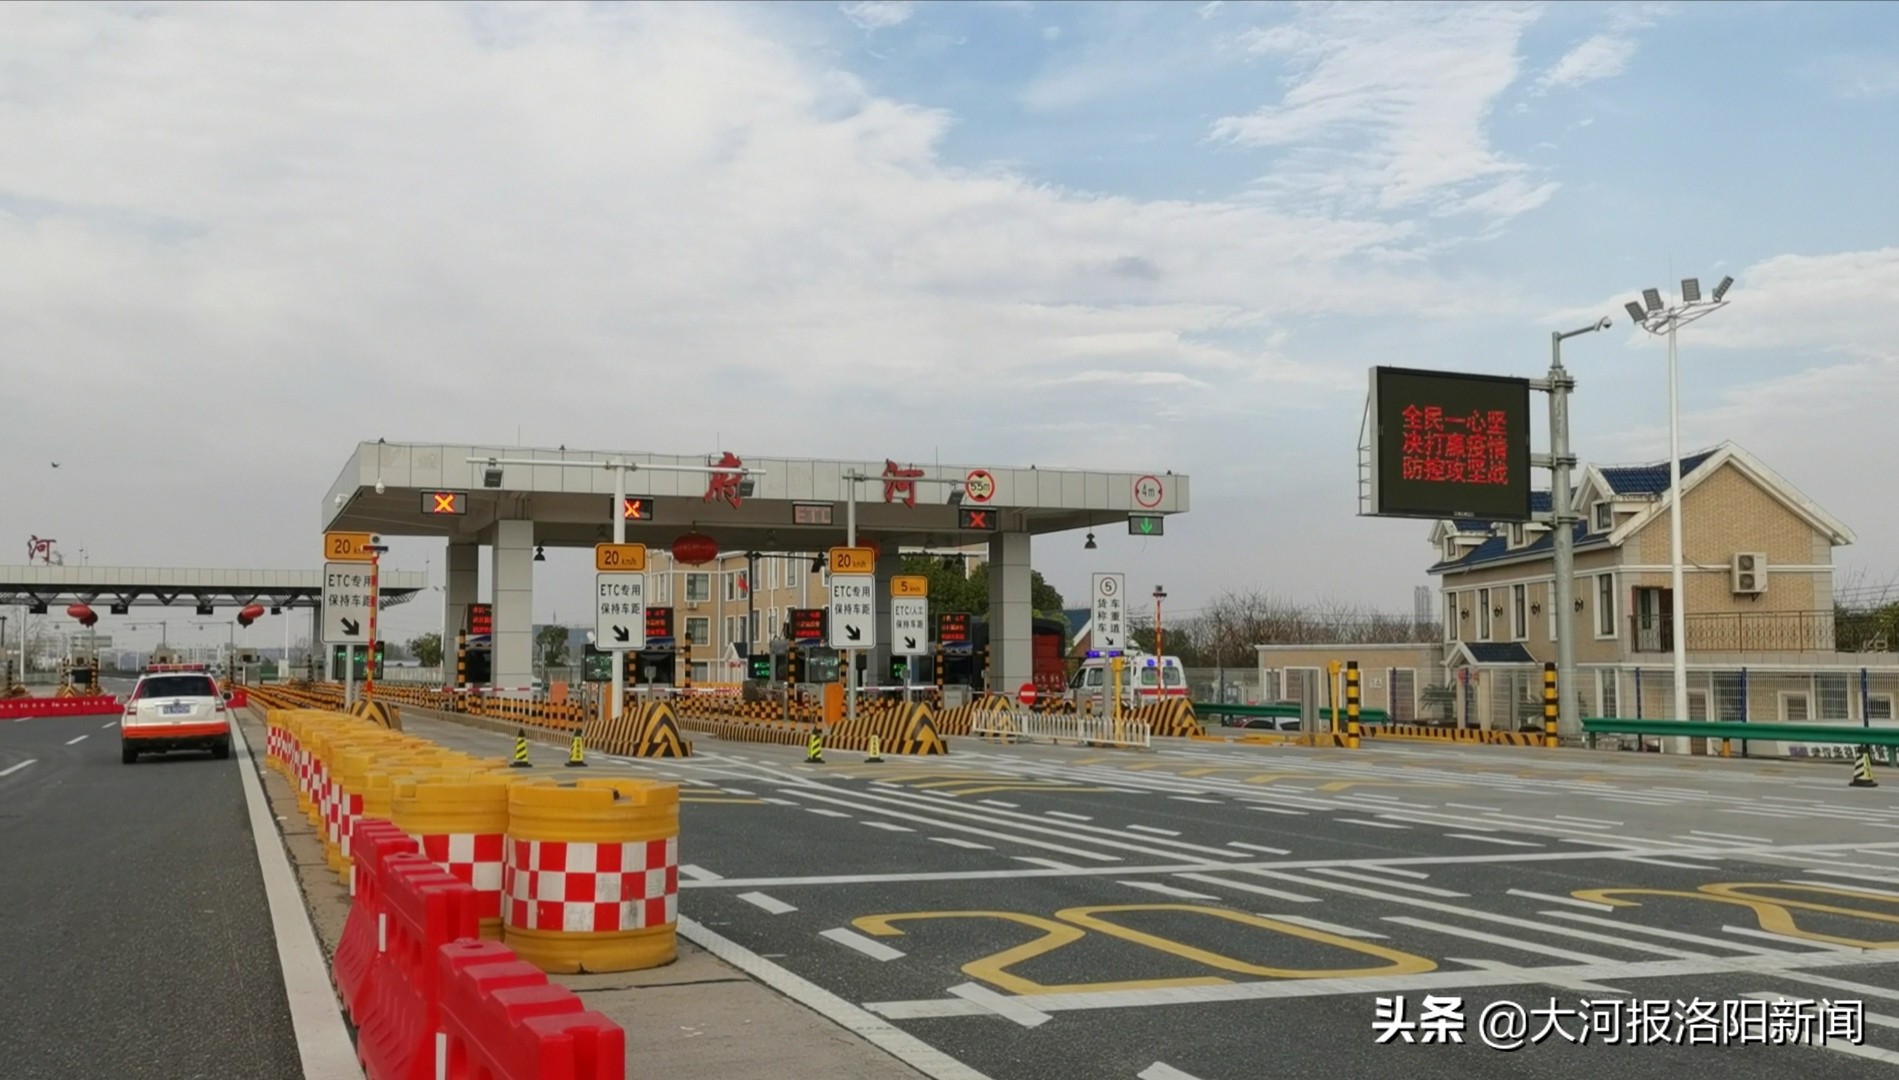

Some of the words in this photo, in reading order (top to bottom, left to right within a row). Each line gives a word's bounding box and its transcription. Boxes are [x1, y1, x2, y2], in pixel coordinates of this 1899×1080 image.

[1401, 404, 1507, 435] 全民一心坚
[1402, 432, 1508, 460] 决打赢疫情
[1403, 457, 1509, 485] 防控攻坚战
[703, 451, 742, 510] 府
[882, 458, 925, 509] 河
[27, 534, 57, 563] 河
[334, 538, 351, 554] 20
[604, 550, 619, 565] 20
[837, 554, 851, 568] 20
[600, 584, 641, 596] ETC专用
[833, 585, 871, 598] ETC专用
[901, 581, 908, 592] 5
[1104, 581, 1112, 592] 5
[600, 603, 641, 615] 保持车距
[834, 603, 871, 615] 保持车距
[895, 605, 924, 616] ETC/人工
[895, 619, 924, 630] 保持车距
[851, 904, 1438, 996] 20
